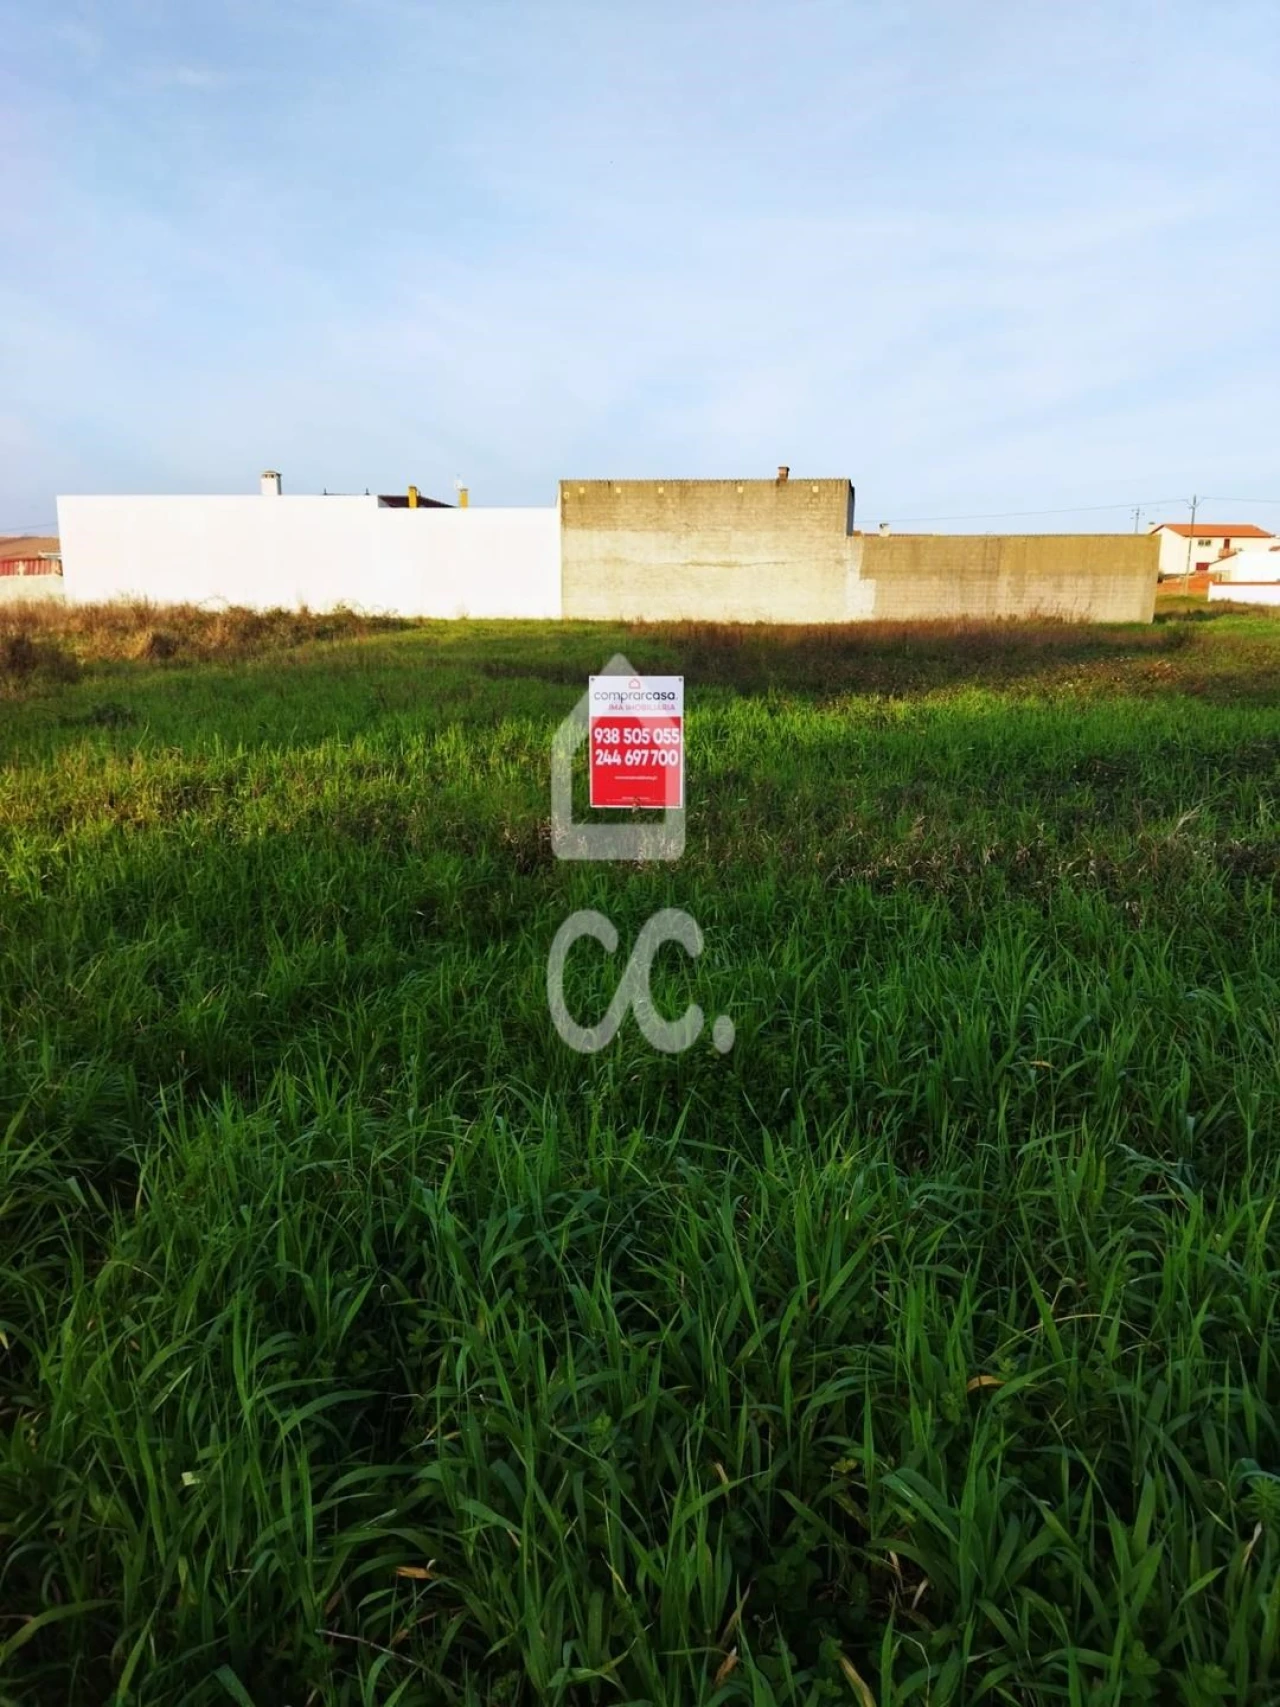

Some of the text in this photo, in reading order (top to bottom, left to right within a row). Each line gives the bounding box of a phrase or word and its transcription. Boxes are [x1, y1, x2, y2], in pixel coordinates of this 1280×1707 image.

[594, 728, 680, 744] 938 505 055
[595, 749, 678, 766] 244 697 700
